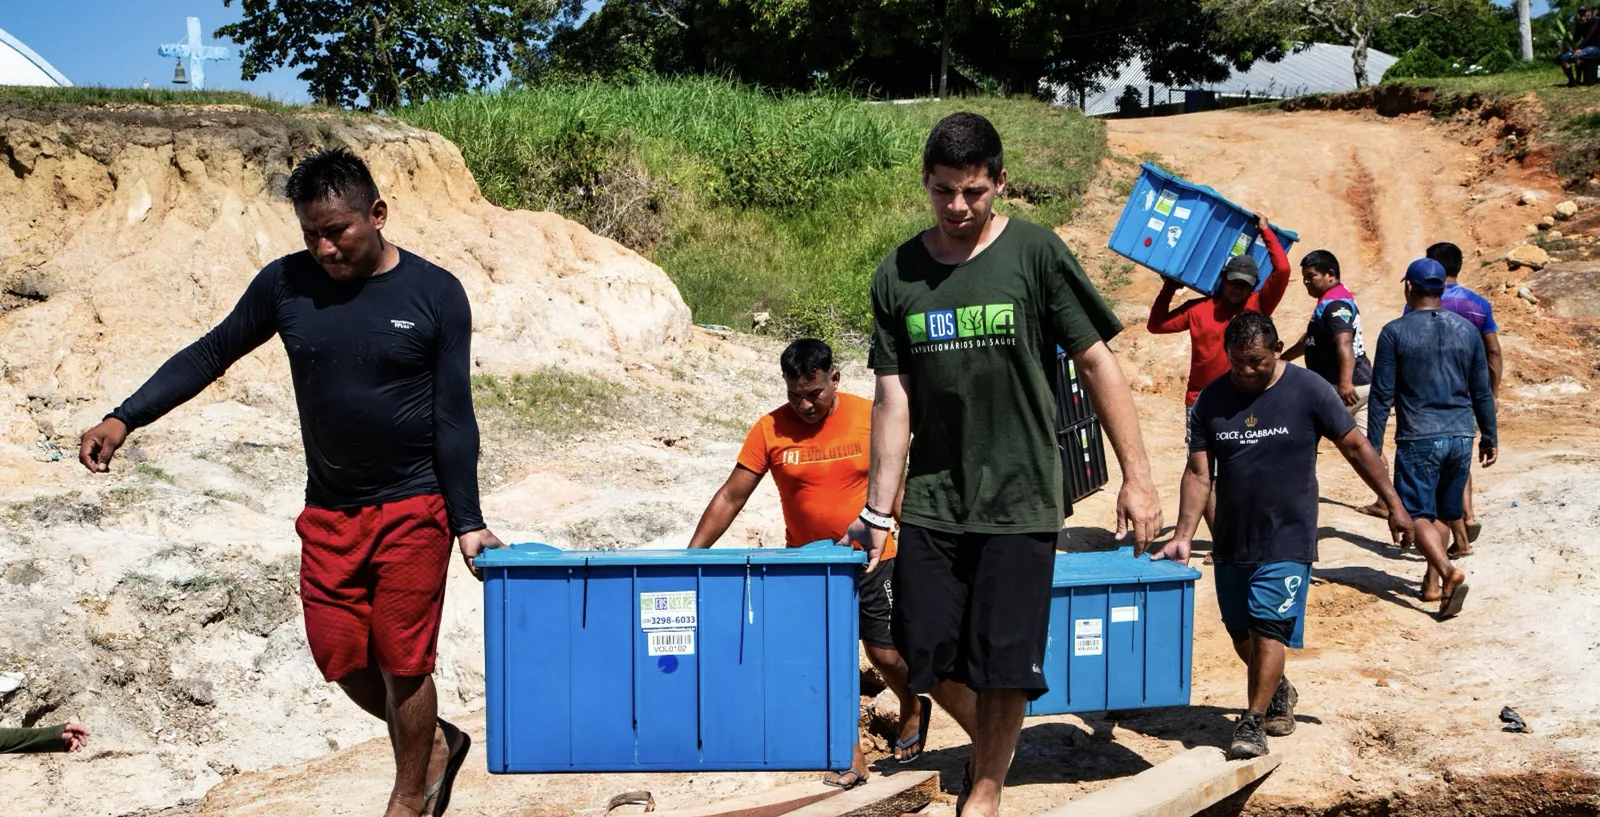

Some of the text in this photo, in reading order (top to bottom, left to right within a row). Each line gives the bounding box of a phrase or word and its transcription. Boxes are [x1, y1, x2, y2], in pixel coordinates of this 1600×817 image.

[929, 313, 955, 338] EDS
[911, 336, 1016, 354] EXPDICIONÁRIOS DA SAÚDE
[1216, 430, 1239, 440] DOLCE
[1244, 427, 1289, 439] GABBANA
[651, 615, 696, 625] 3298-6033
